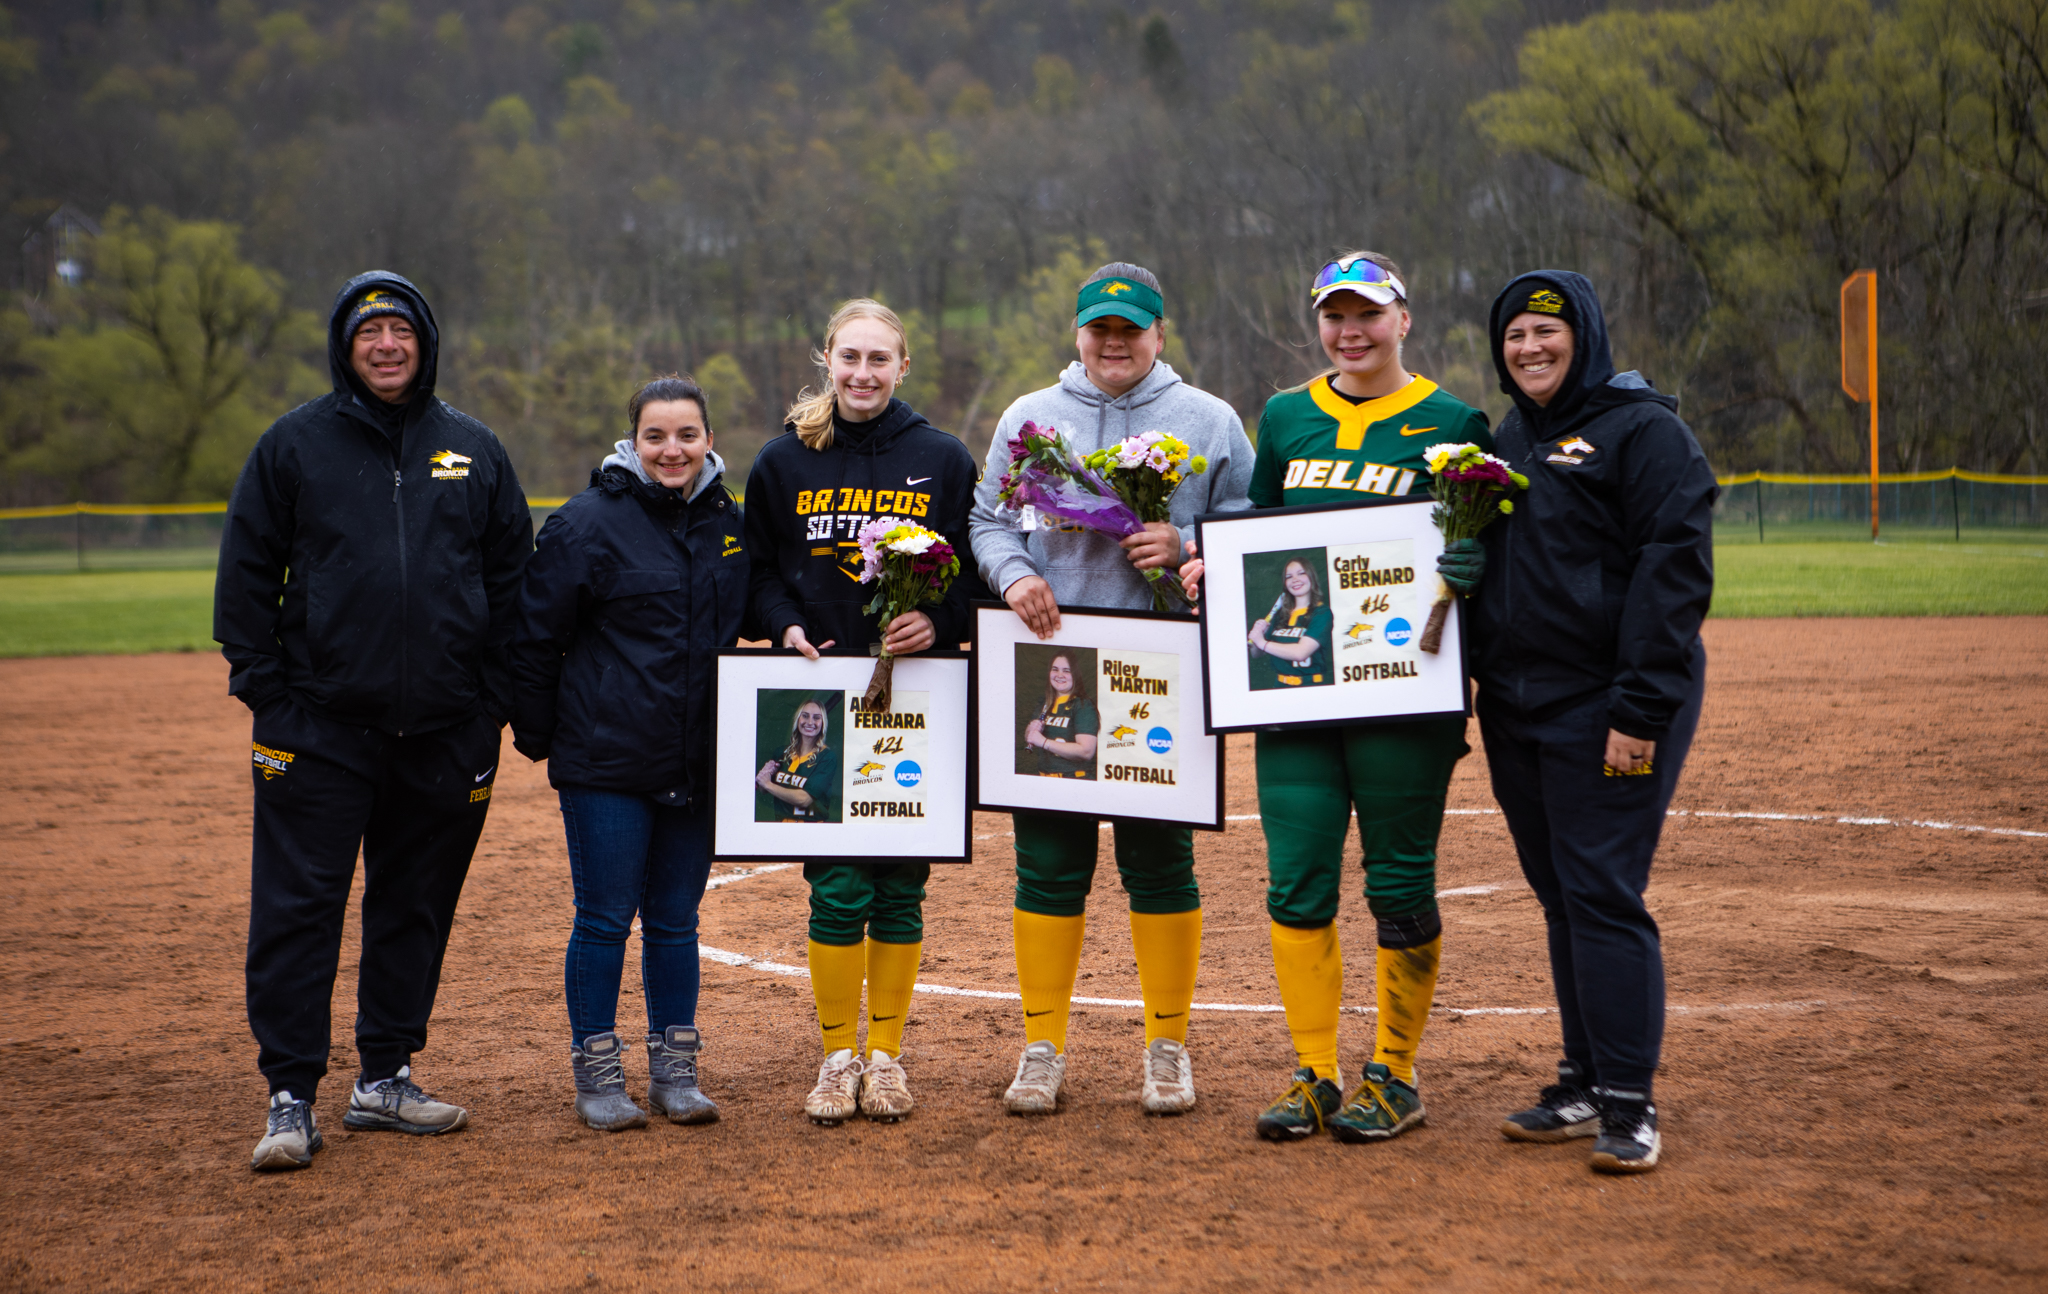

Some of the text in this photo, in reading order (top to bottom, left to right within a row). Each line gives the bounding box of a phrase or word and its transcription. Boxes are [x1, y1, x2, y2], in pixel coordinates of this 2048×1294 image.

[431, 469, 470, 478] BRONCOS
[1283, 459, 1418, 497] DELHI
[796, 487, 932, 518] BRONCOS
[1333, 554, 1371, 574] Carly
[1339, 566, 1416, 590] BERNARD
[1360, 593, 1390, 615] #16
[1102, 659, 1140, 679] Riley
[1342, 660, 1419, 683] SOFTBALL
[1110, 675, 1169, 696] MARTIN
[1128, 701, 1150, 720] #6
[854, 712, 926, 730] FERRARA
[252, 741, 295, 763] BRONCOS
[872, 735, 904, 755] #21
[1148, 738, 1173, 749] NCAA
[253, 751, 287, 771] SOFTBALL
[896, 772, 921, 782] NCAA
[1104, 763, 1176, 786] SOFTBALL
[850, 800, 925, 818] SOFTBALL
